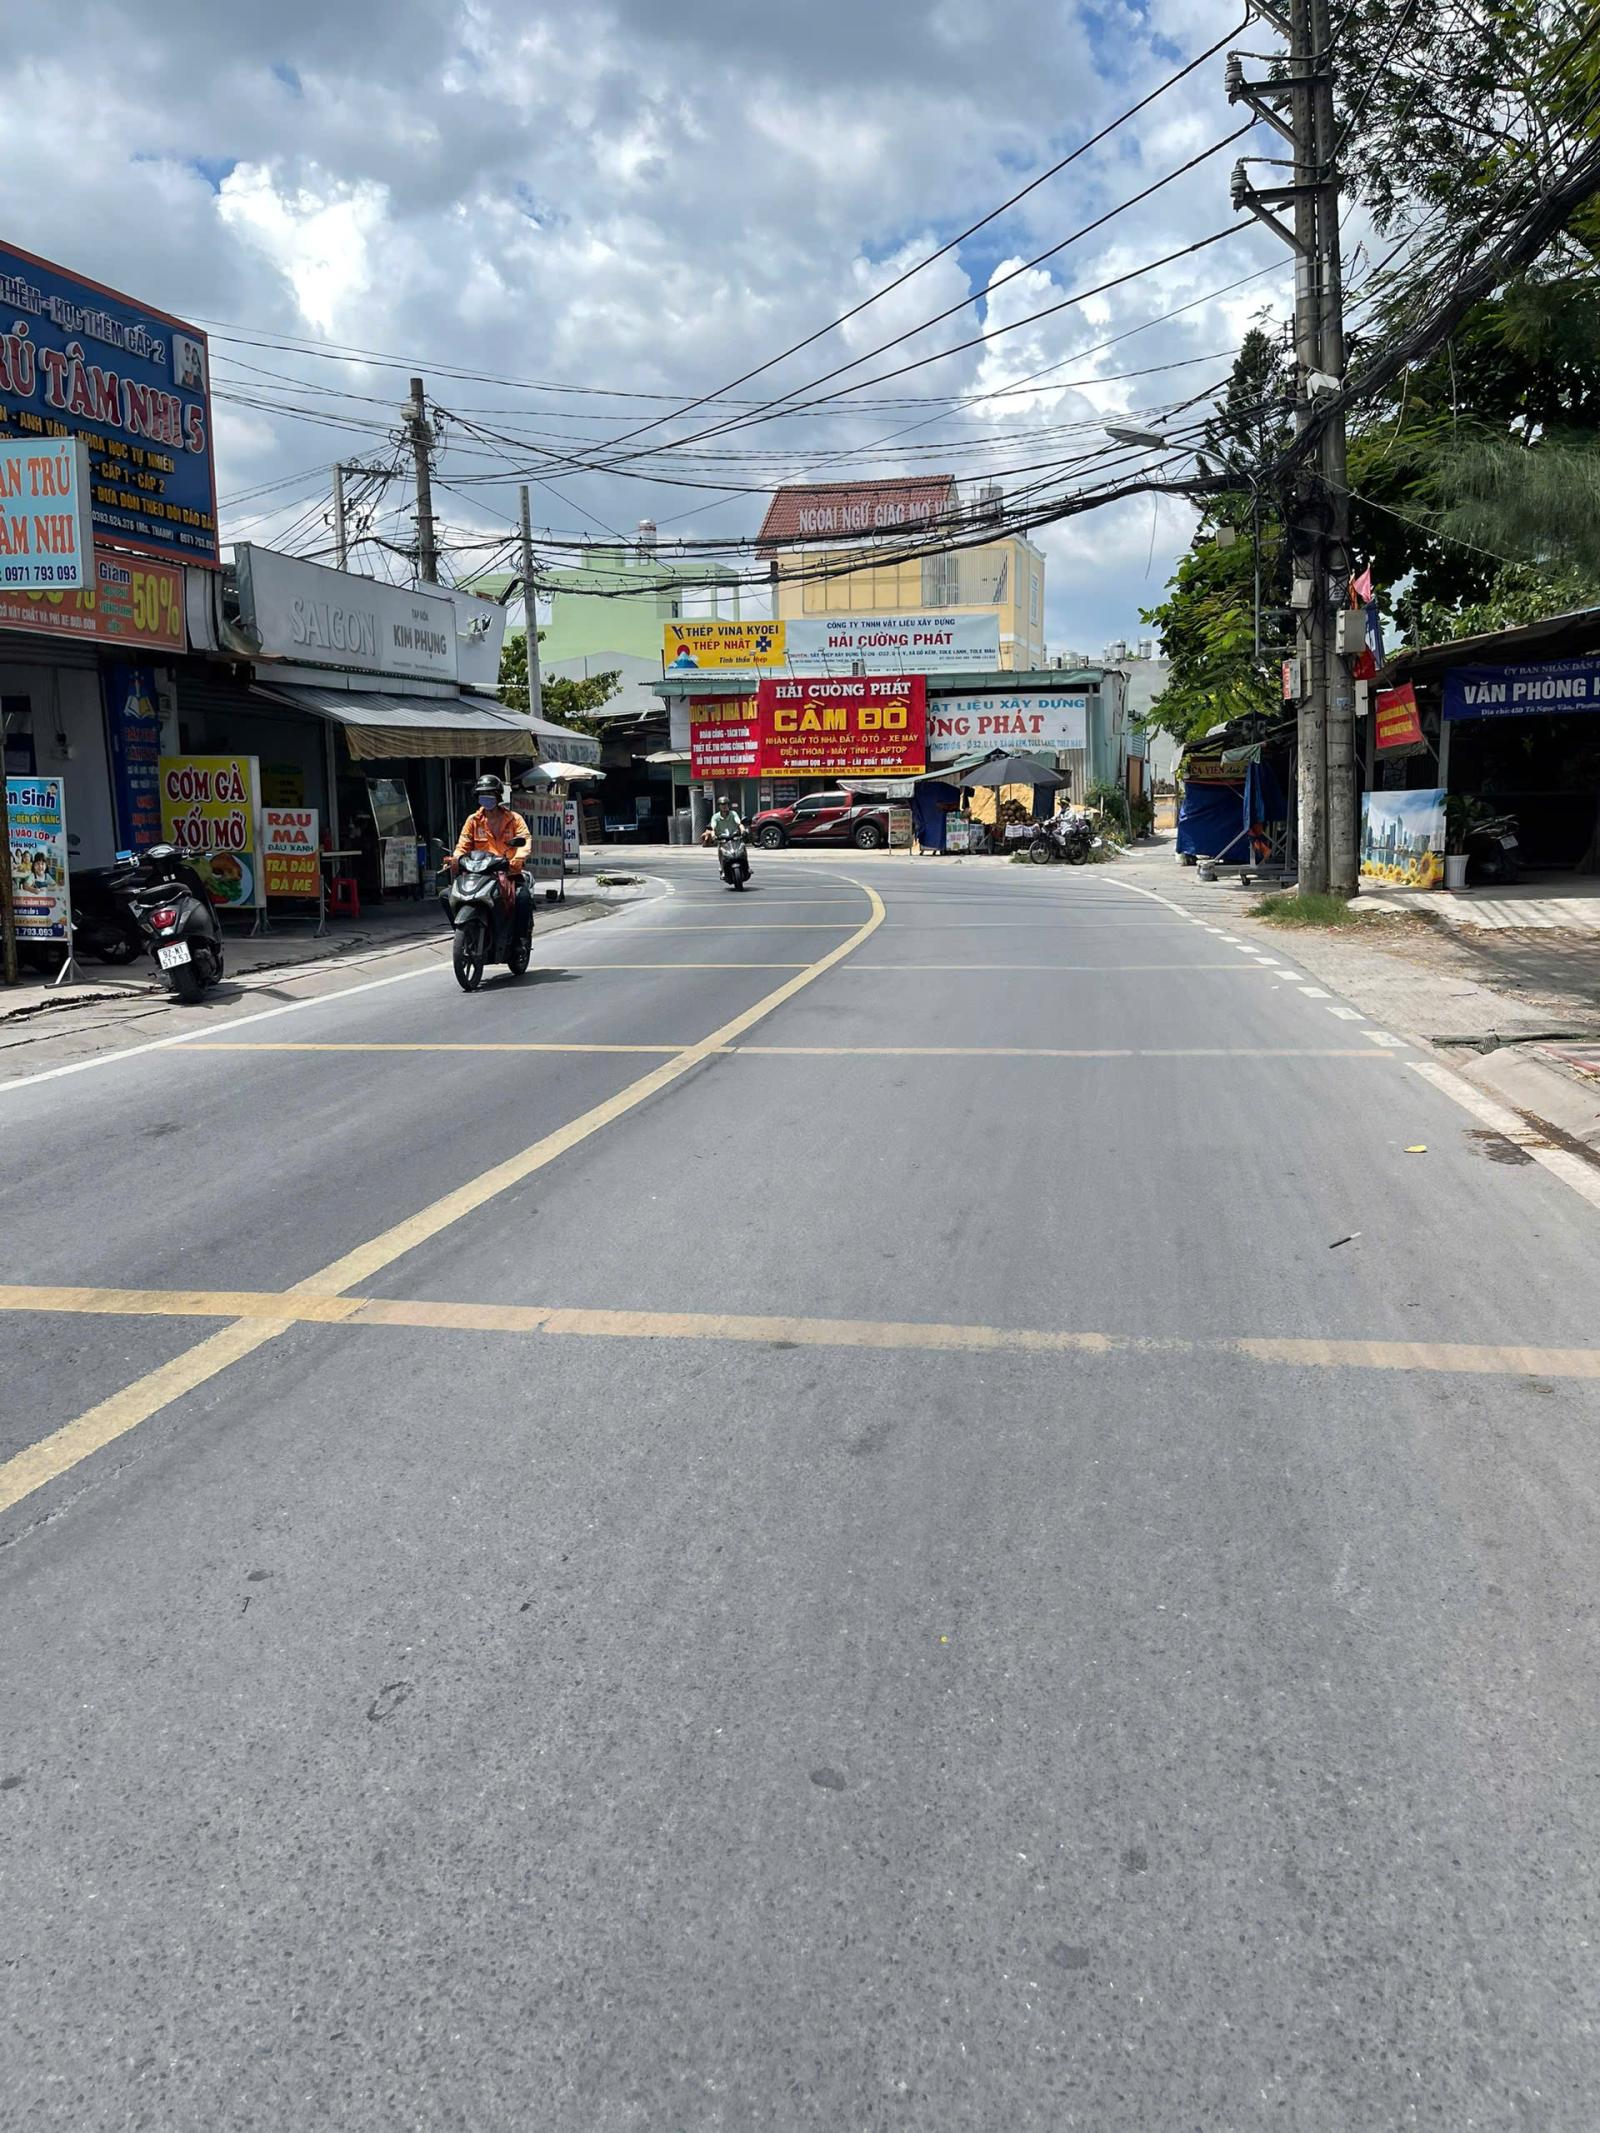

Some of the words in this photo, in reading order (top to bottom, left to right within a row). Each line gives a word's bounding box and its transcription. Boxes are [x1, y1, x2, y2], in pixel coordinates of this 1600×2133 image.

[152, 340, 166, 365] 2
[40, 341, 122, 427] TÂM
[120, 378, 184, 448] NHI
[184, 404, 205, 454] 5
[28, 444, 70, 496] TRÚ
[158, 479, 165, 493] 2
[34, 515, 76, 553] NHI
[5, 566, 30, 581] 0971
[34, 565, 54, 580] 793
[57, 565, 77, 580] 093
[132, 571, 179, 635] 50%
[686, 624, 713, 637] THÉP
[718, 626, 743, 636] VINA
[747, 625, 779, 635] KYOEI
[826, 620, 847, 629] CÔNG
[393, 624, 413, 648] KIM
[414, 629, 447, 659] PHỤNG
[693, 640, 720, 651] THÉP
[828, 631, 853, 647] HẢI
[913, 629, 953, 646] PHÁT
[775, 682, 803, 698] HẢI
[870, 678, 911, 695] PHÁT
[1464, 681, 1506, 704] VĂN
[1512, 676, 1587, 701] PHÒNG
[774, 699, 847, 732] CẦM
[857, 696, 911, 730] ĐỒ
[930, 702, 950, 715] ẬT
[957, 700, 994, 712] LIỆU
[1000, 697, 1031, 710] XÂY
[1038, 697, 1084, 710] DỰNG
[977, 708, 1044, 735] PHÁT
[875, 746, 907, 754] LAPTOP
[167, 766, 210, 801] CƠM
[214, 761, 246, 801] GÀ
[22, 788, 55, 808] Sinh
[172, 807, 211, 849] XỐI
[213, 811, 247, 849] MỠ
[267, 813, 312, 827] RAU
[34, 829, 50, 841] LỚP
[290, 844, 314, 852] XANH
[292, 878, 313, 892] ME
